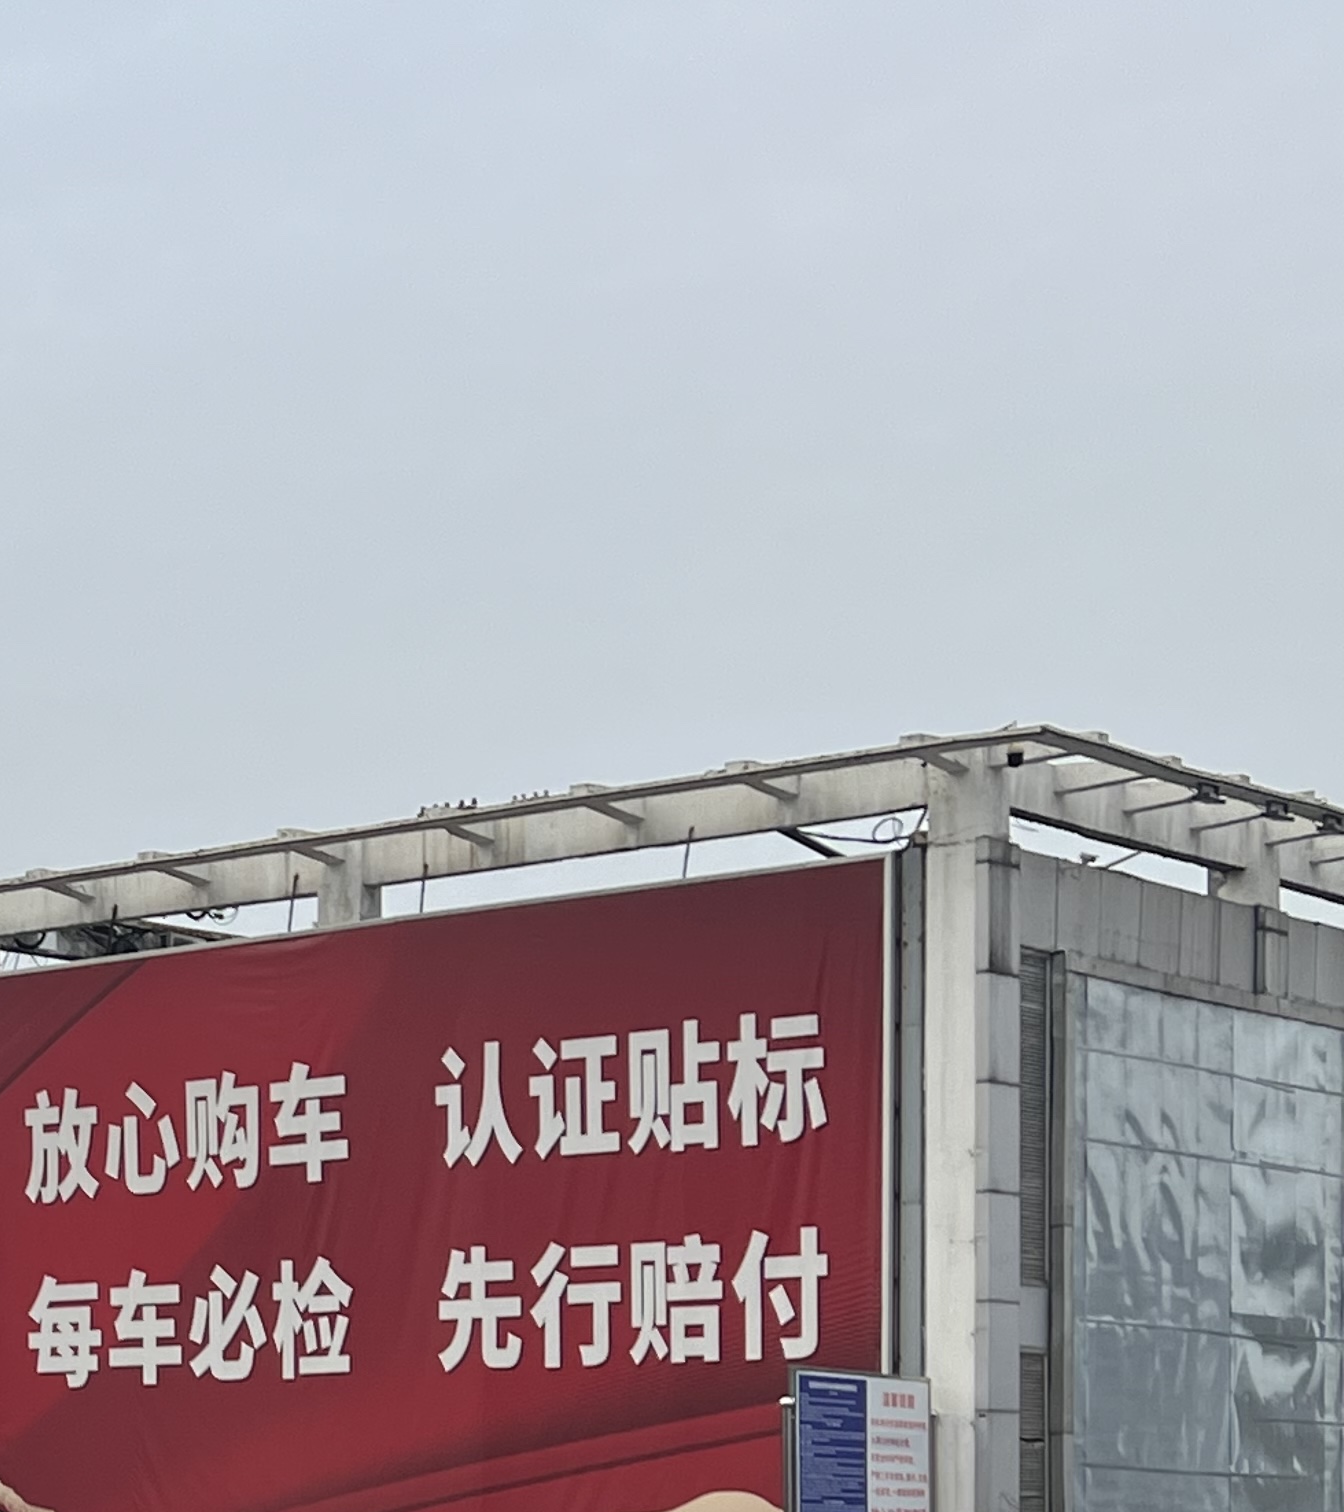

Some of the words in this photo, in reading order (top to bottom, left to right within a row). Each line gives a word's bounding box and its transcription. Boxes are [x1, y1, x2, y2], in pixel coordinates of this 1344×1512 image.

[24, 1062, 349, 1204] 放心购车
[435, 1013, 827, 1168] 认证贴标
[28, 1257, 353, 1387] 每车必检
[438, 1226, 828, 1372] 先行赔付
